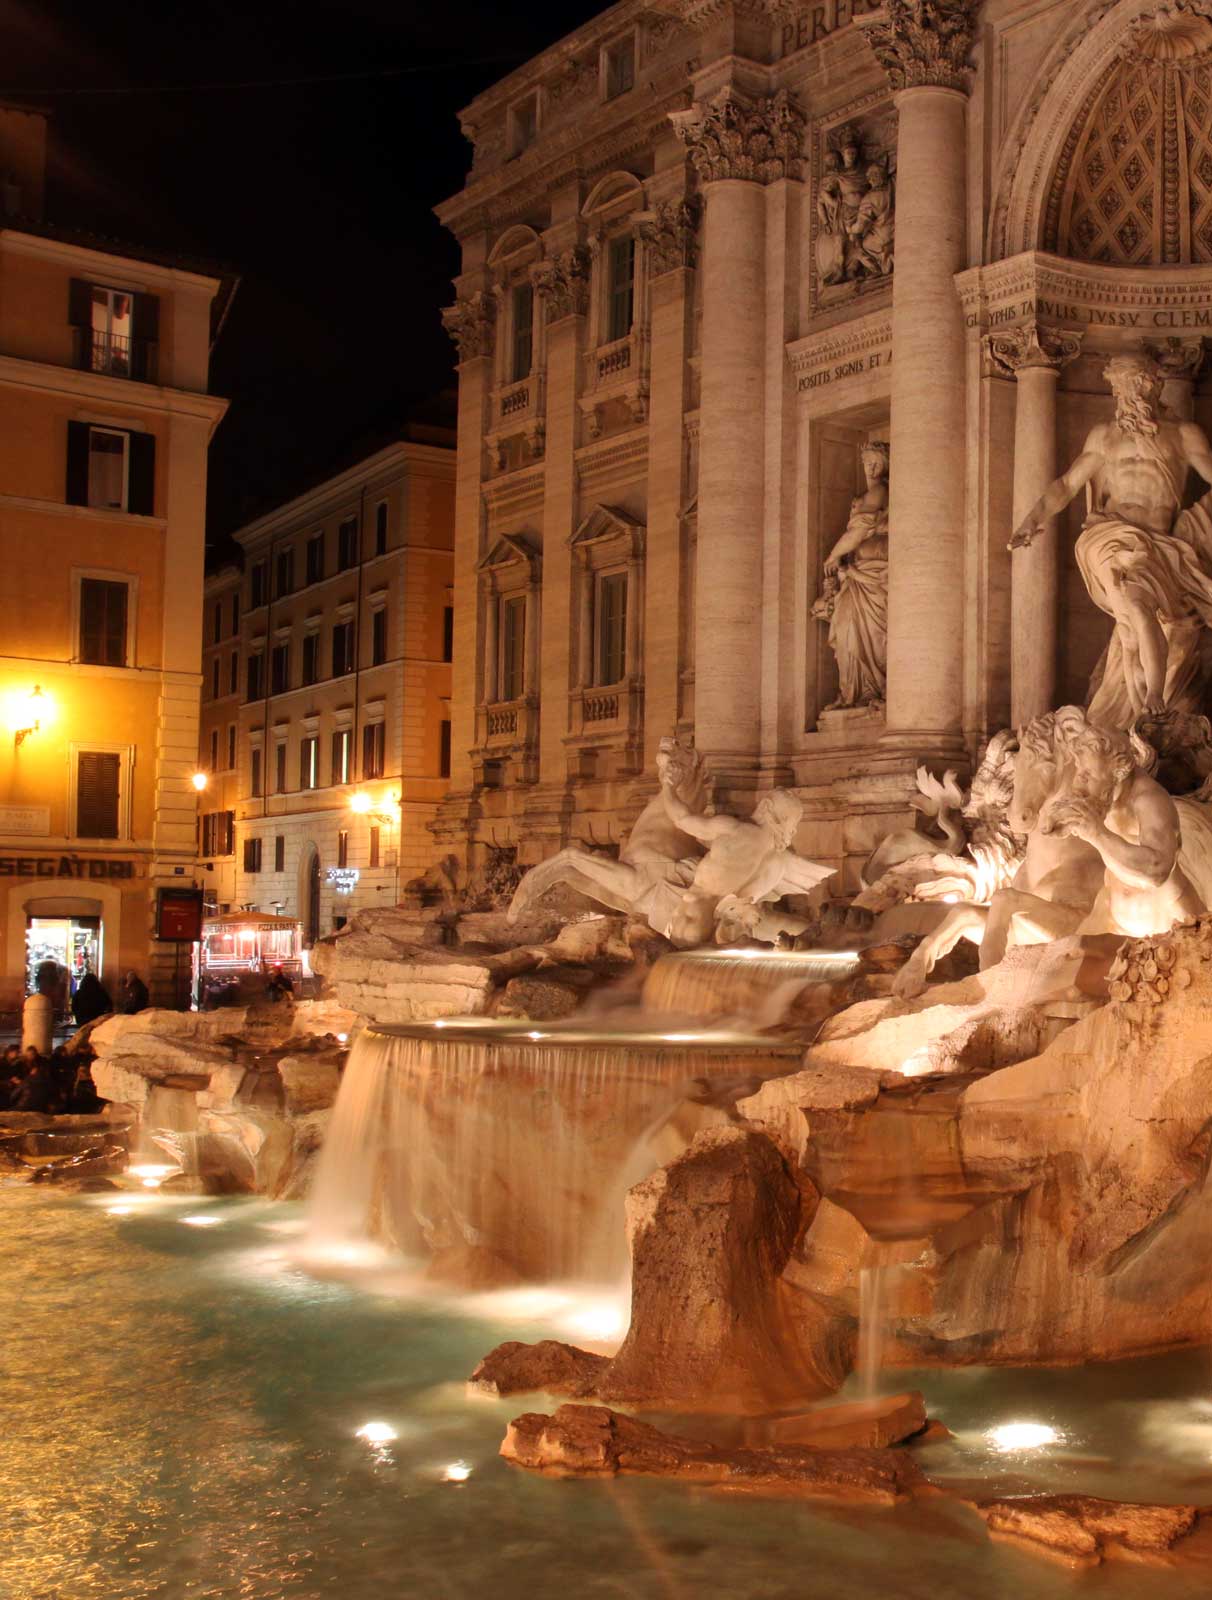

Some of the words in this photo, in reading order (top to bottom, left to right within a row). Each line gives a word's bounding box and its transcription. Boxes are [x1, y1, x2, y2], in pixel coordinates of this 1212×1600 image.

[1088, 308, 1141, 327] IVSSV
[798, 369, 831, 393] POSITIS
[834, 359, 864, 380] SIGNIS
[869, 353, 882, 369] ET
